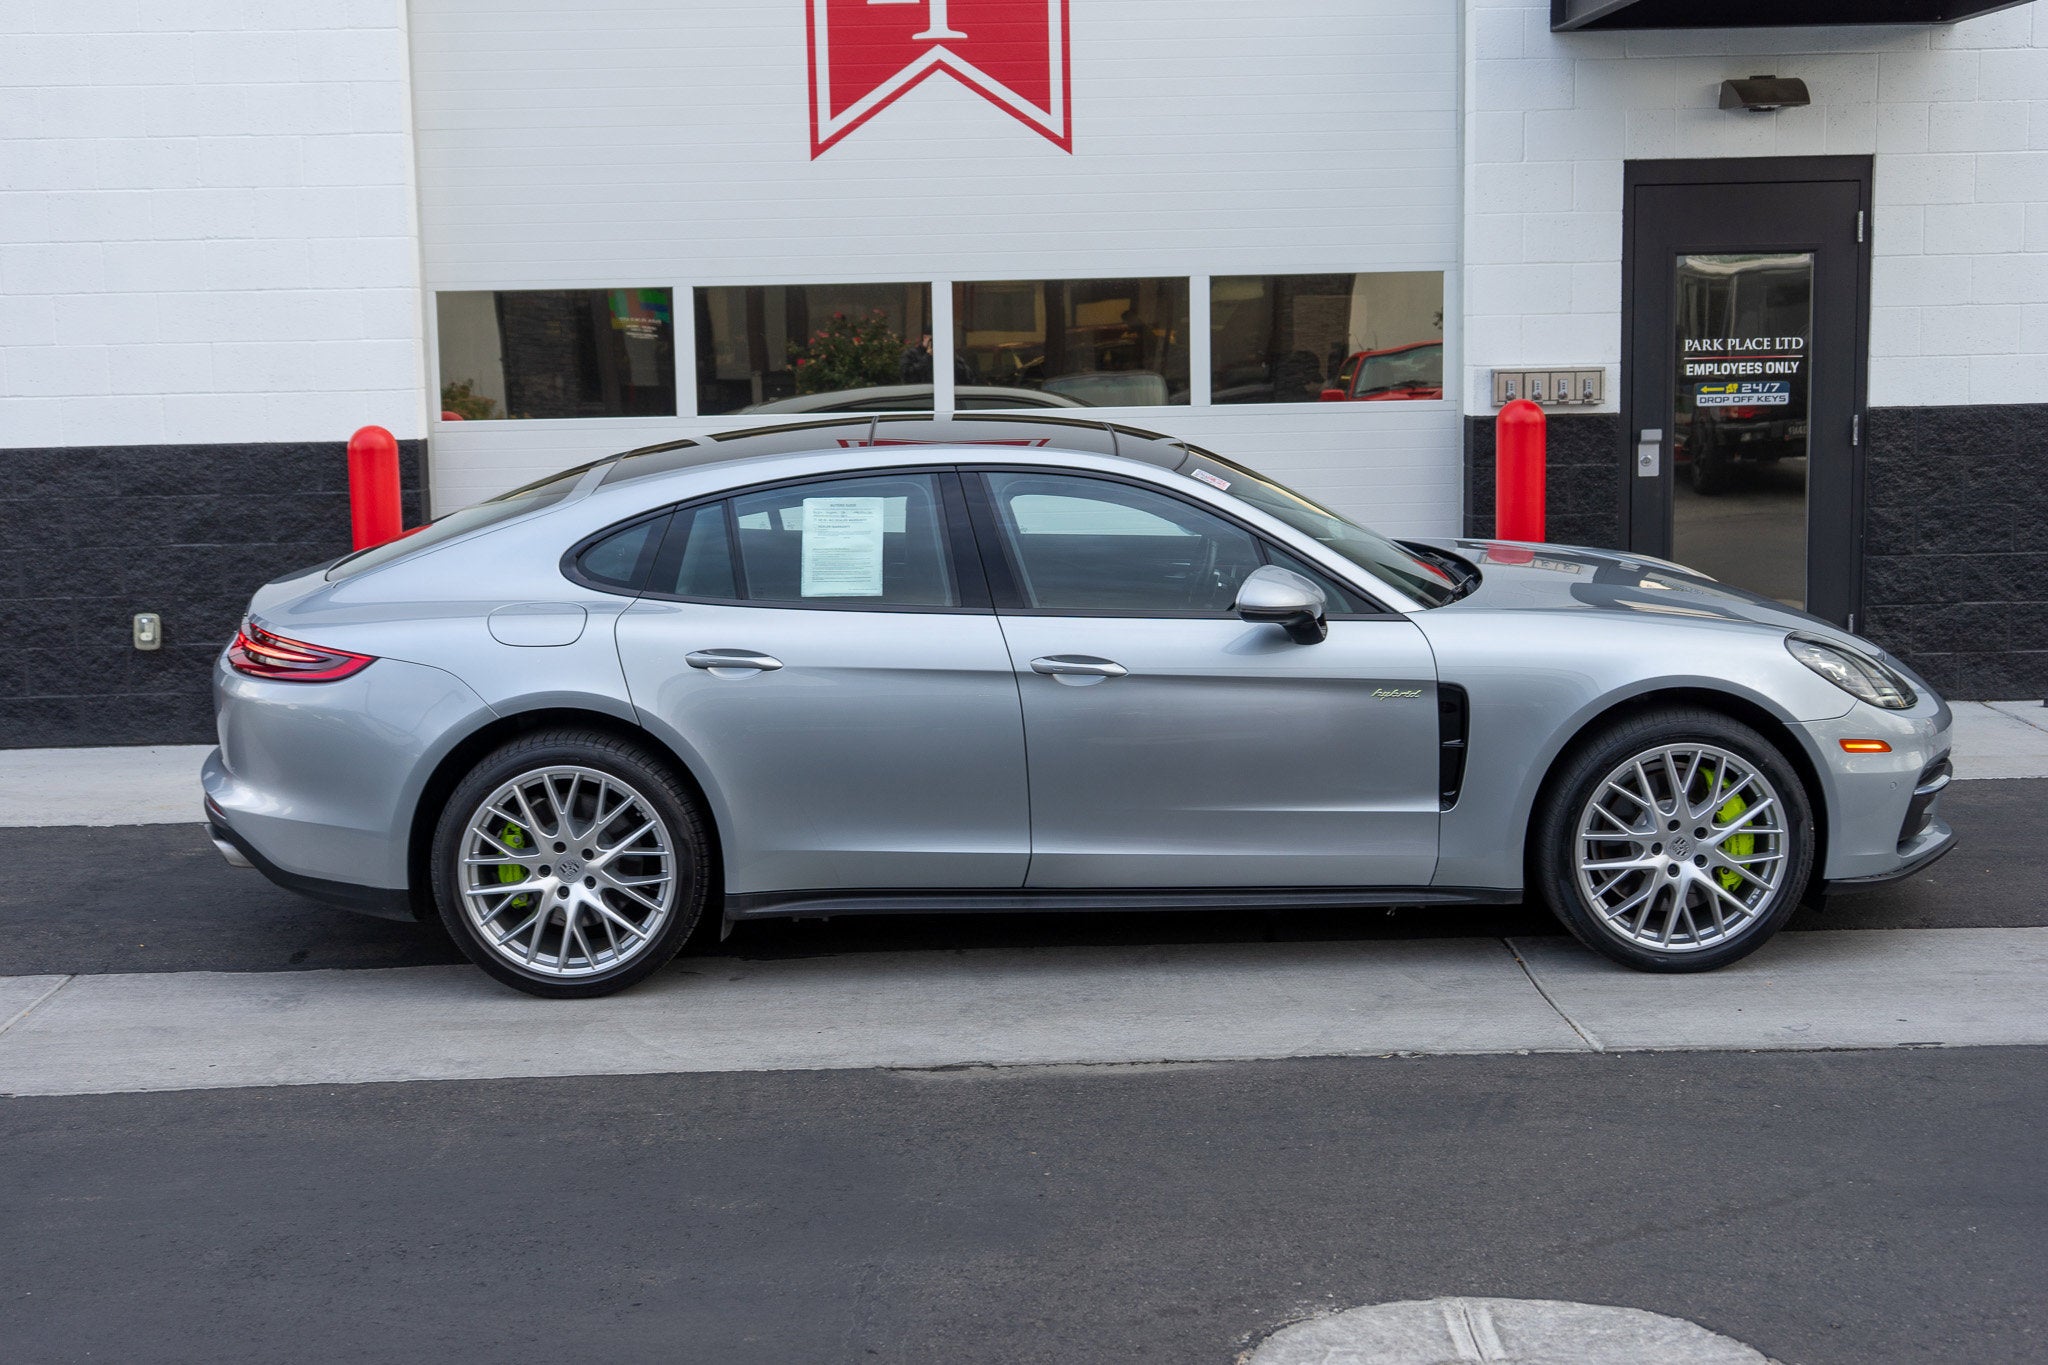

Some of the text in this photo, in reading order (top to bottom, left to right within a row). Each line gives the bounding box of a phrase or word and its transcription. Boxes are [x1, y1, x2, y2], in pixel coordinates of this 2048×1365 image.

[1684, 337, 1804, 351] PARK PLACE LTD
[1686, 362, 1800, 375] EMPLOYEES ONLY
[1742, 383, 1780, 392] 24/7
[1371, 688, 1422, 700] hybrid
